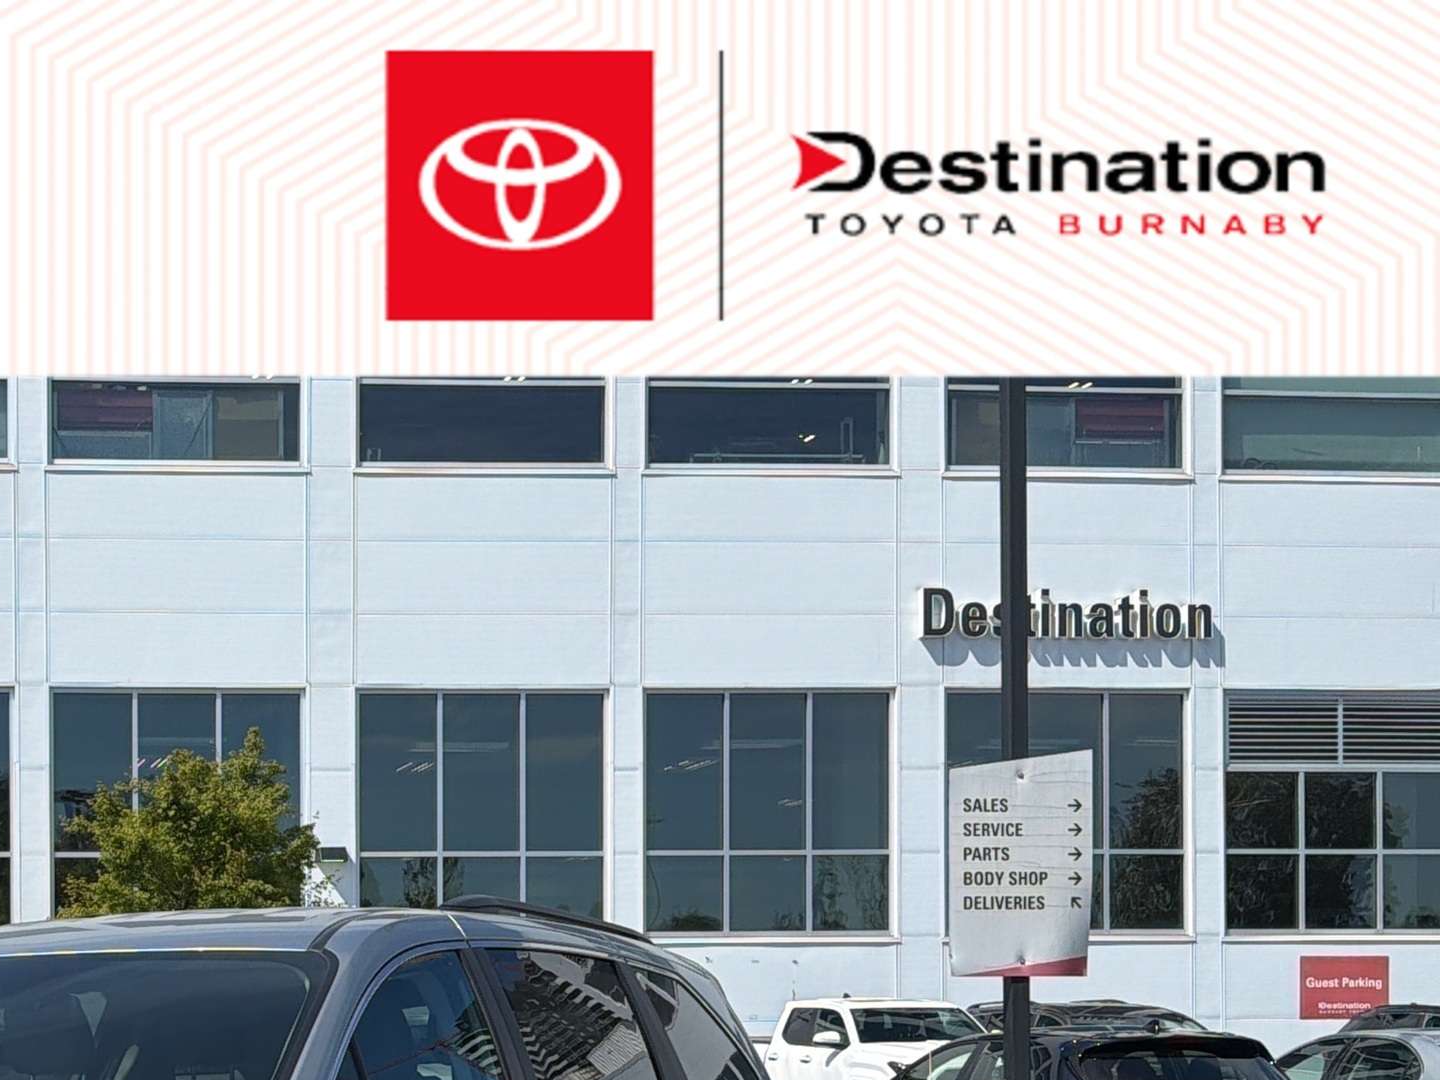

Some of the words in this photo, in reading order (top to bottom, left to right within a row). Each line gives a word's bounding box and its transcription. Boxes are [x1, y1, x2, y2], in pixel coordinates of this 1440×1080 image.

[962, 798, 1009, 813] SALES
[962, 822, 1024, 837] SERVICE
[962, 846, 1011, 861] PARTS
[962, 871, 1005, 886] BODY
[1008, 871, 1049, 886] SHOP
[962, 895, 1046, 910] DELIVERIES
[1306, 977, 1339, 988] Guest
[1342, 977, 1383, 990] Parking
